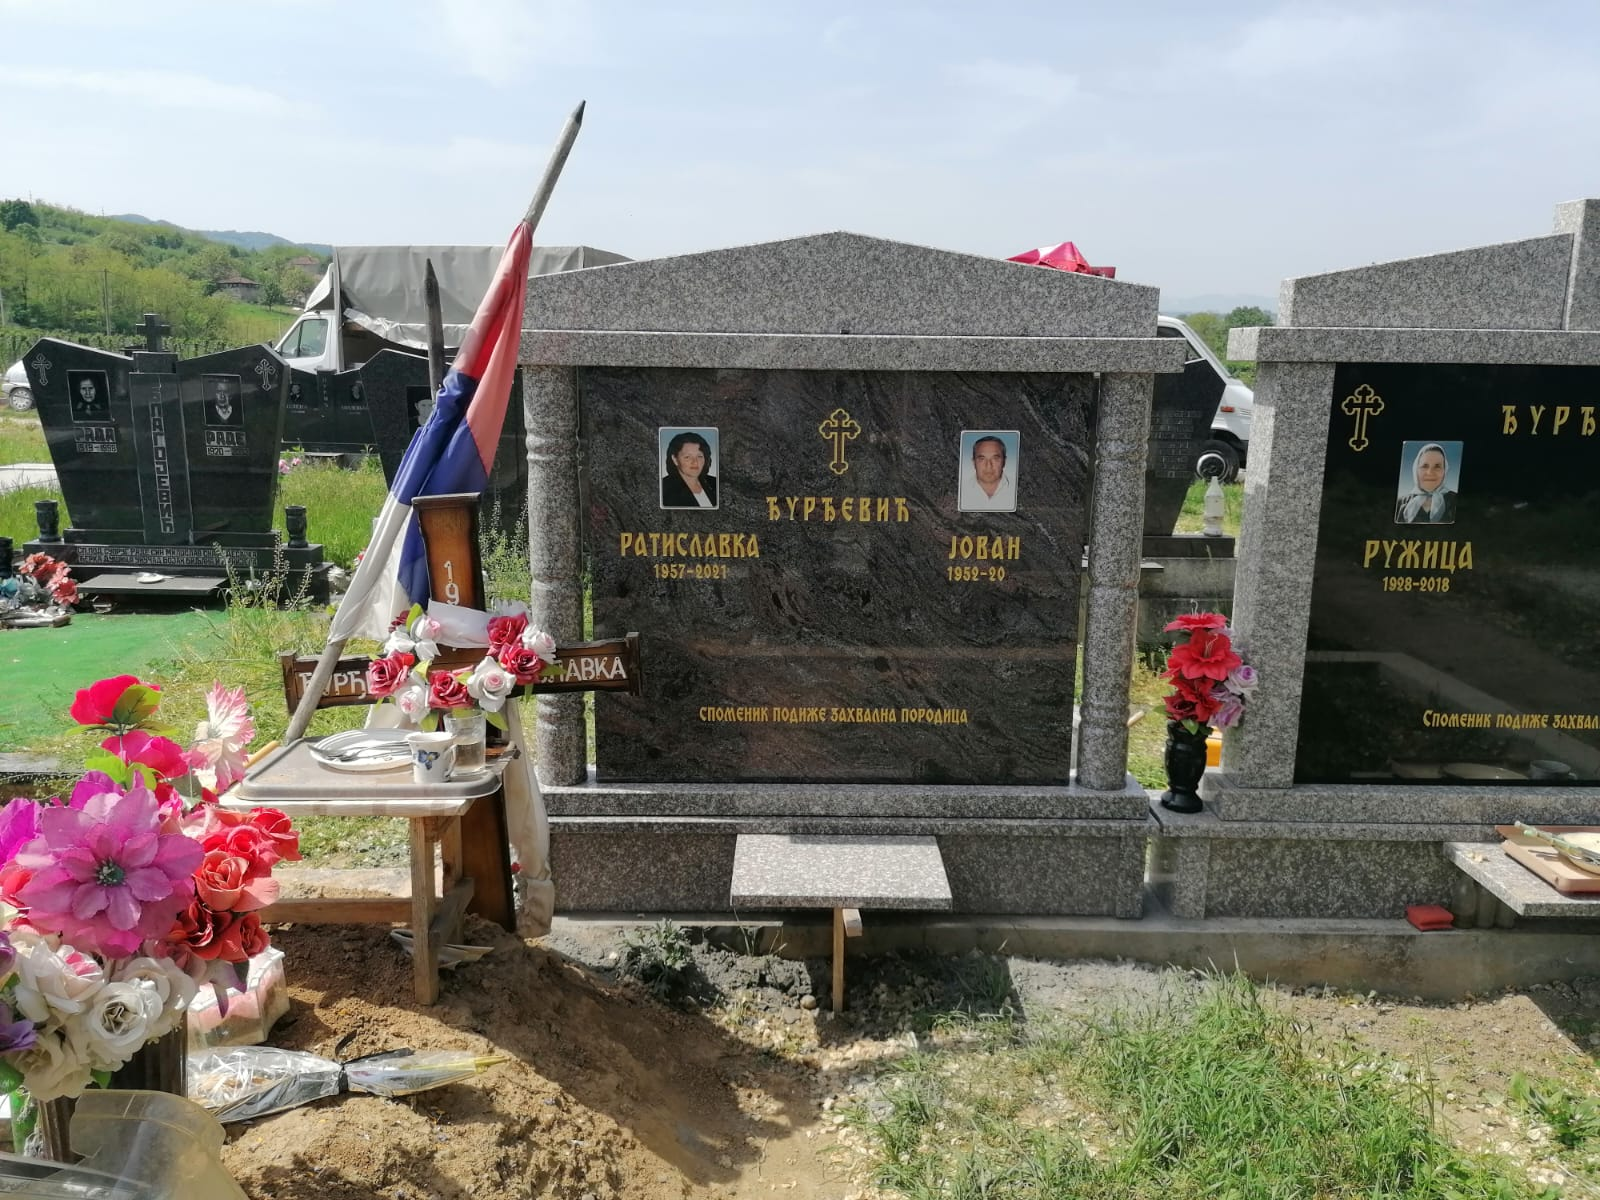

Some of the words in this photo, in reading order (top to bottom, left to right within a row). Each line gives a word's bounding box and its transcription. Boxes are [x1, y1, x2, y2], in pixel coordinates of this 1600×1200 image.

[1502, 405, 1597, 436] ЂУРЂ
[766, 496, 910, 522] ЂУРЂЕВИЋ
[620, 532, 760, 558] РАТИСЛАВКА
[948, 535, 1020, 560] ЈОВАН
[1363, 540, 1473, 575] РУЖИЦА
[654, 563, 728, 579] 1957-2021
[947, 566, 1006, 582] 1952-20
[1383, 576, 1450, 592] 1928-2018
[699, 707, 769, 722] СПОМЕНИК
[772, 707, 826, 723] ПОДИЖЕ
[830, 708, 897, 723] ЗАХВАЛНА
[901, 709, 968, 725] ПОРОДИЦА
